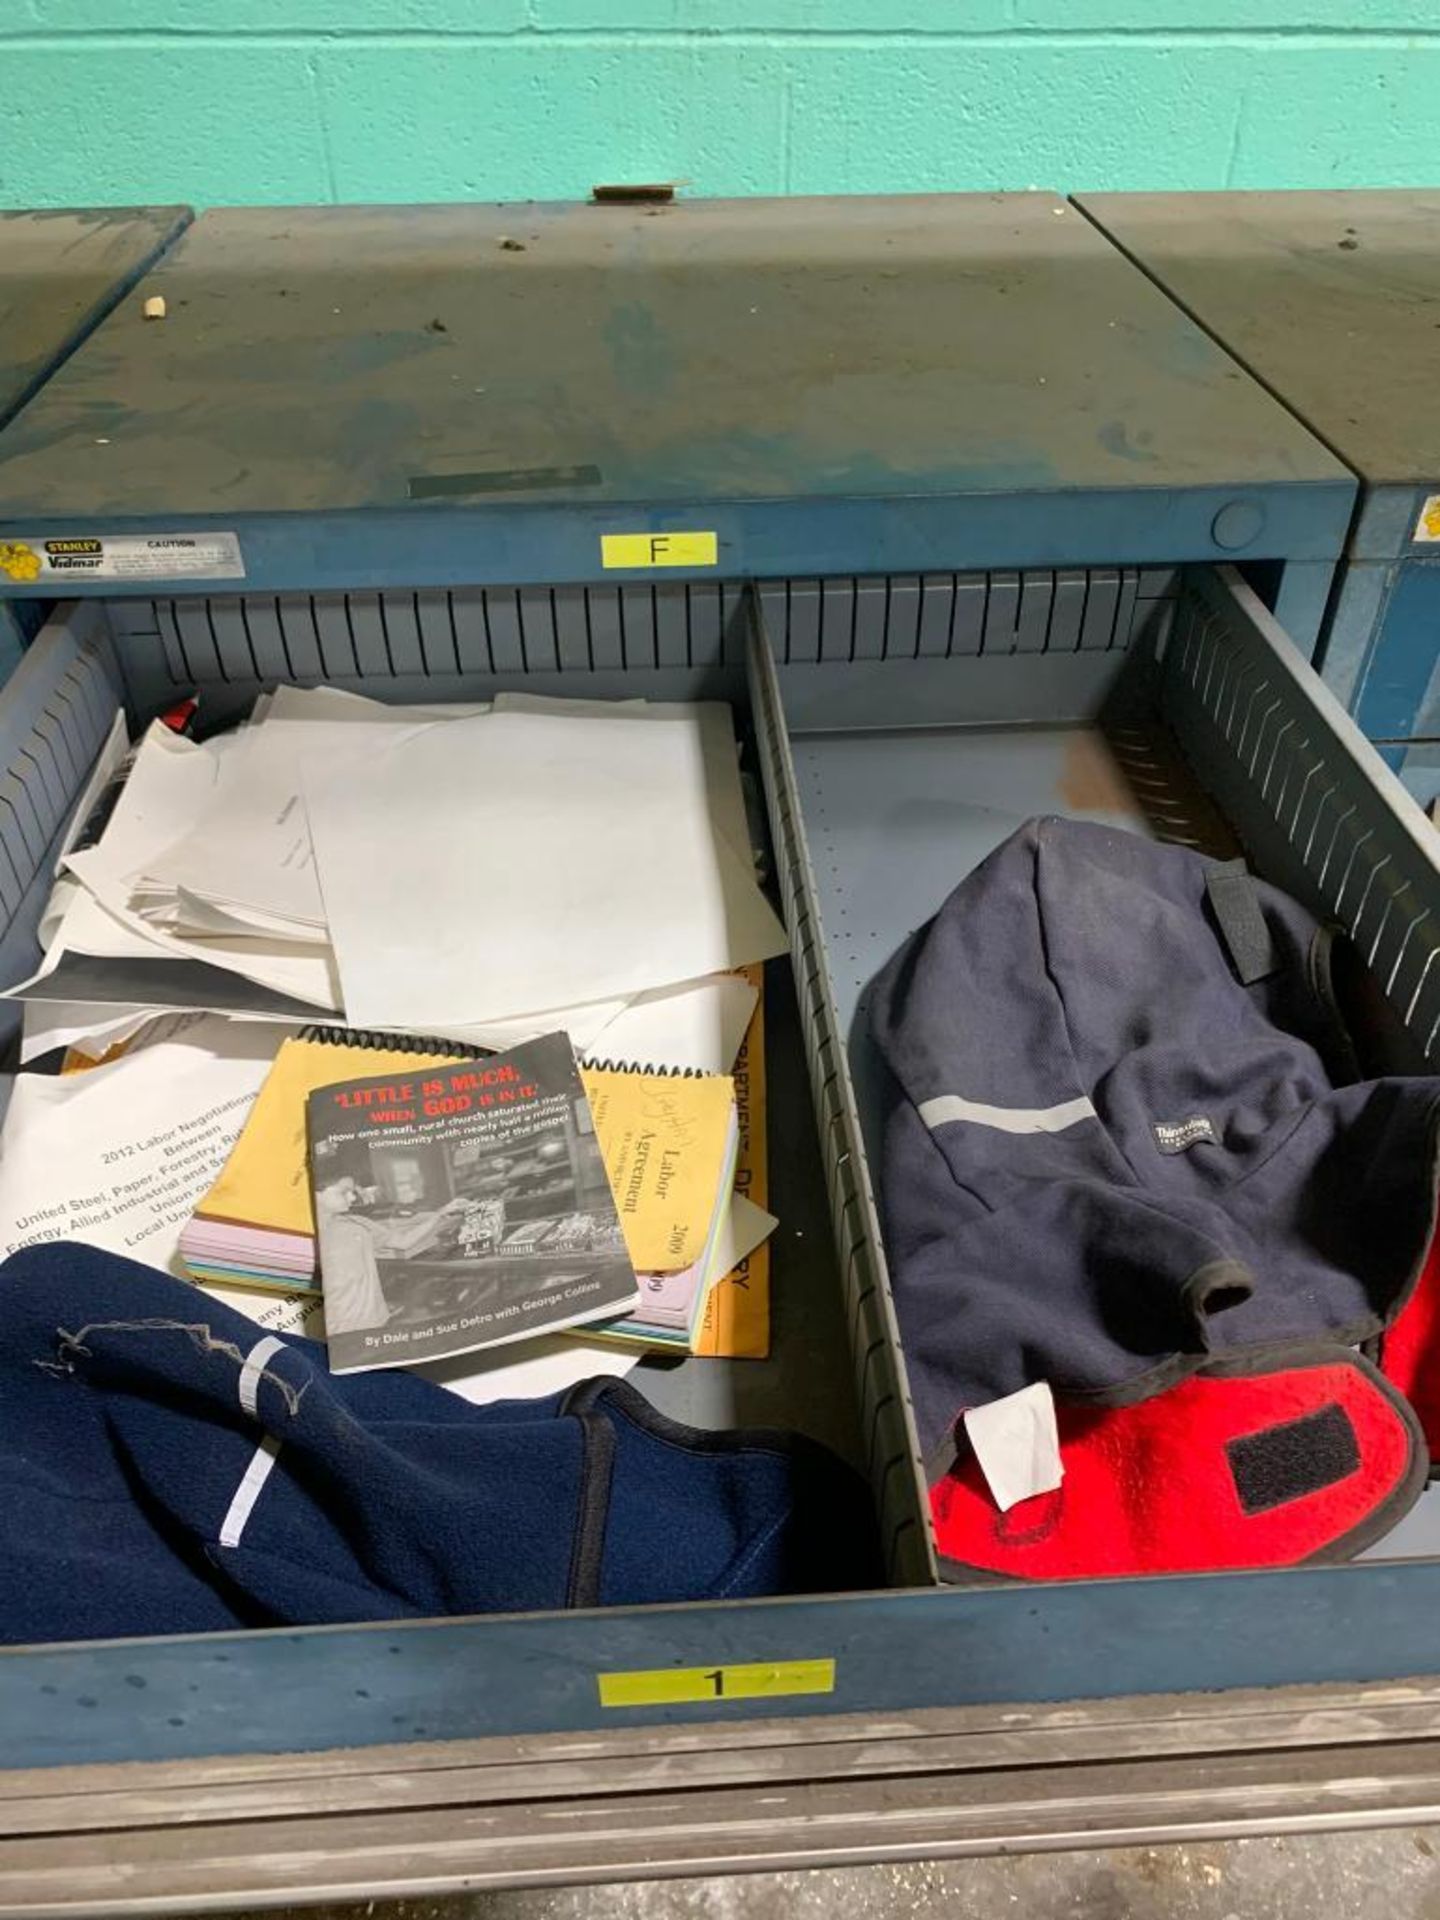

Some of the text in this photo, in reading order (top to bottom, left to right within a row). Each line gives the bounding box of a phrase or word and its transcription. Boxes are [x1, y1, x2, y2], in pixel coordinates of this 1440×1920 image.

[48, 542, 98, 552] STANLEY
[147, 539, 196, 549] CAUTION
[651, 537, 670, 563] F
[48, 555, 103, 569] Vidmar
[422, 1079, 444, 1097] IS
[328, 1133, 355, 1144] How
[357, 1128, 381, 1139] one
[382, 1124, 417, 1135] small,
[418, 1118, 446, 1132] rural
[448, 1111, 486, 1126] church
[488, 1098, 541, 1118] saturated
[367, 1108, 417, 1124] WHEN
[423, 1094, 472, 1117] GOD
[480, 1092, 494, 1108] IS
[497, 1088, 517, 1104] IN
[101, 1090, 259, 1165] 2012 Labor Negotiations
[162, 1124, 223, 1158] Between
[367, 1136, 433, 1150] community
[436, 1125, 461, 1140] with
[463, 1121, 498, 1135] nearly
[499, 1115, 522, 1127] half
[533, 1104, 570, 1119] million
[460, 1134, 497, 1148] copies
[498, 1129, 511, 1140] of
[512, 1124, 532, 1136] the
[15, 1130, 243, 1230] United Steel, Paper, Forestry, Ru
[622, 1128, 657, 1213] Agreement
[655, 1149, 680, 1200] Labor
[70, 1210, 112, 1231] Allied
[112, 1178, 181, 1216] Industrial
[182, 1164, 209, 1183] and
[149, 1190, 193, 1214] Union
[123, 1217, 166, 1248] Local
[668, 1223, 690, 1255] 2009
[364, 1281, 601, 1348] By Dale and Sue Detro with George Collins
[704, 1670, 724, 1696] 1
